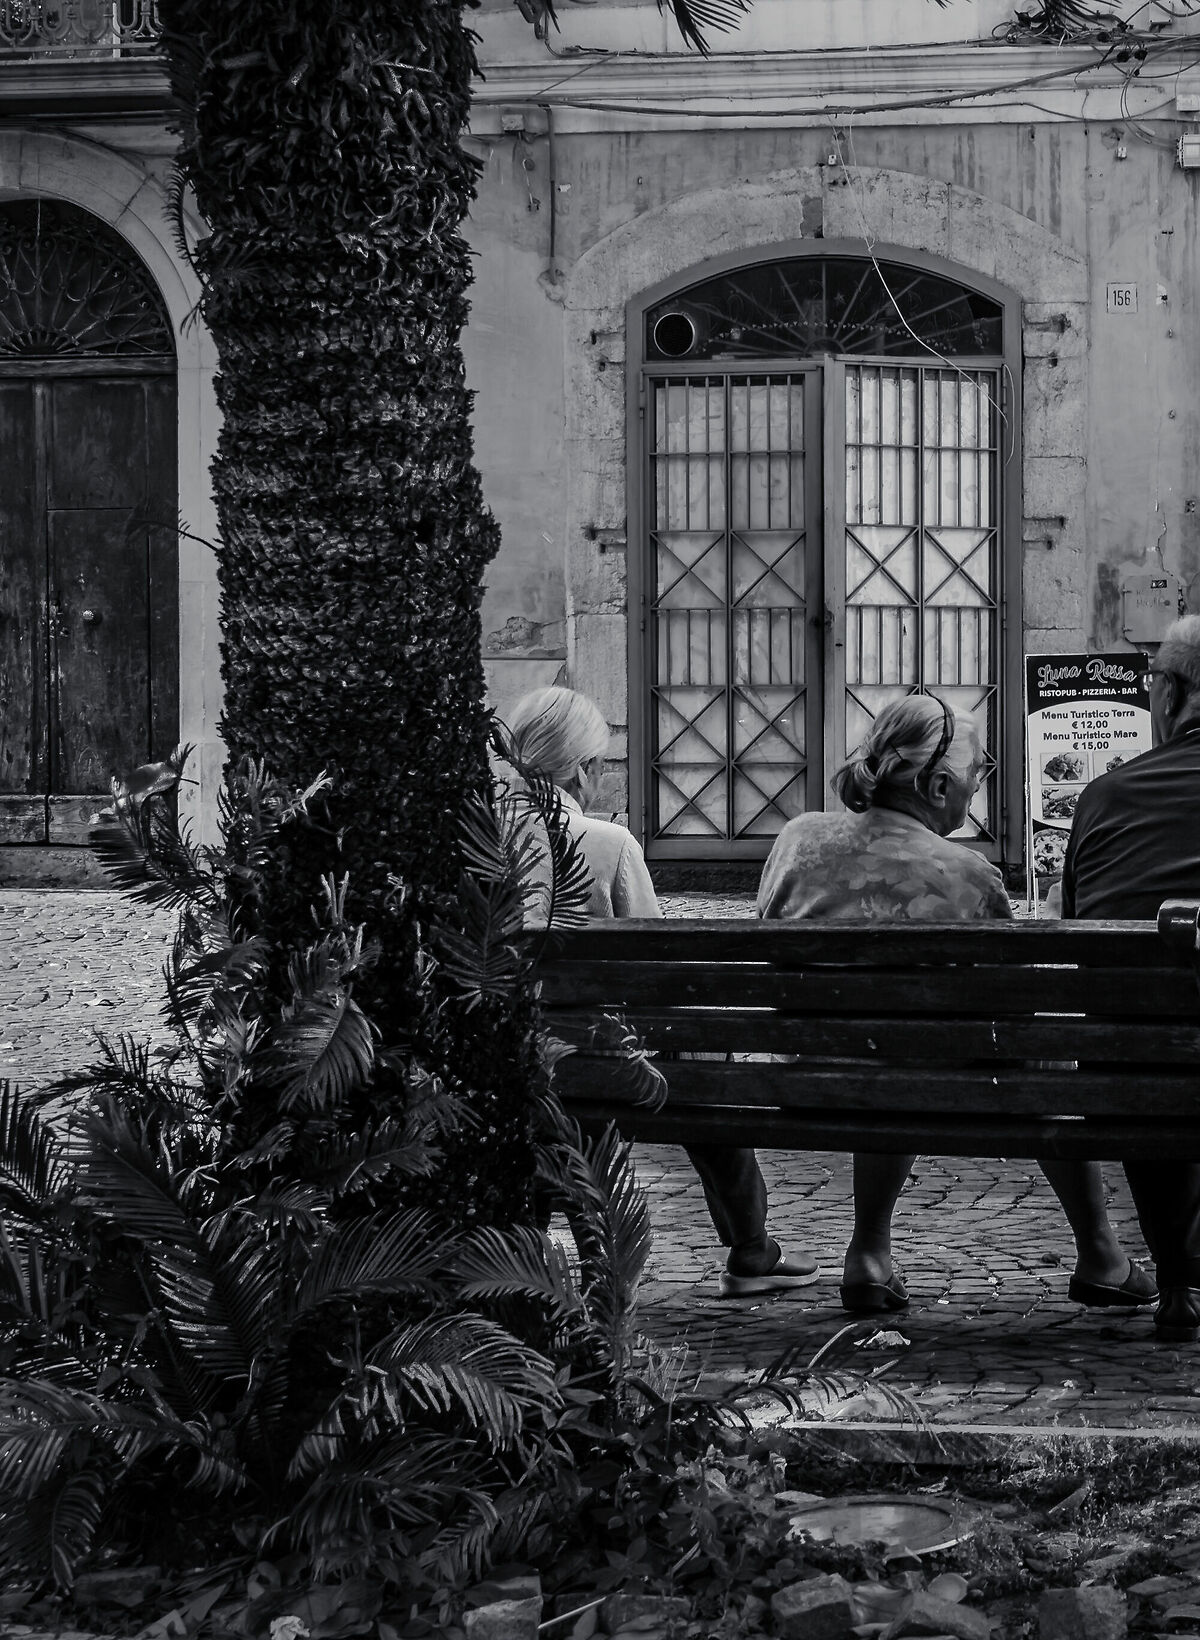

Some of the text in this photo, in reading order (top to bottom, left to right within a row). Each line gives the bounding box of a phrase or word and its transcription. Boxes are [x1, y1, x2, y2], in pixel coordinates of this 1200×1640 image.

[1113, 290, 1130, 306] 156
[1037, 658, 1137, 688] Luna Rossa
[1082, 688, 1117, 696] PIZZERIA
[1122, 687, 1138, 695] BAR
[1041, 709, 1135, 719] Menu Turistico Terra
[1071, 720, 1108, 730] € 12,00
[1043, 730, 1138, 741] Menu Turistico Mare
[1072, 741, 1109, 751] € 15,00
